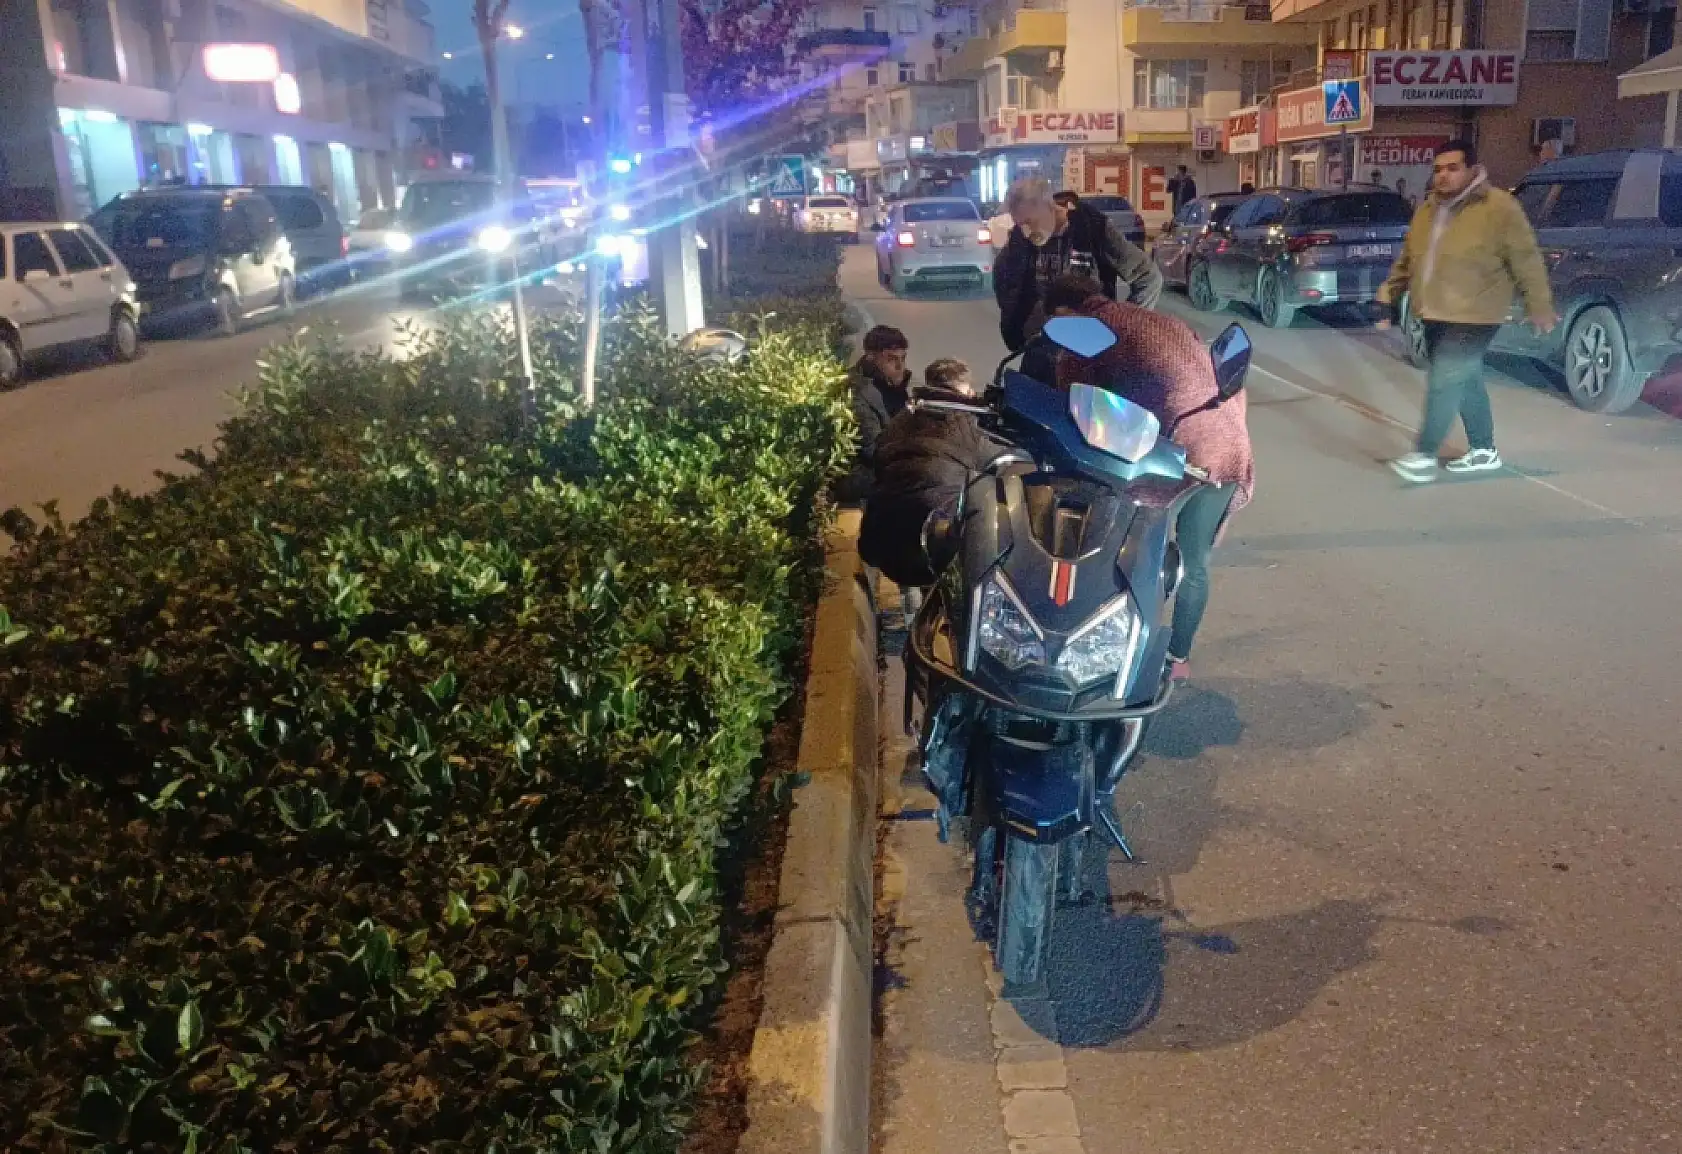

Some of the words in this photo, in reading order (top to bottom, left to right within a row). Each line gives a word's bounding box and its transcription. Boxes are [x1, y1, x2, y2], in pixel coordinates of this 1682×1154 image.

[1373, 55, 1515, 85] ECZANE
[1031, 112, 1115, 131] ECZANE
[1361, 144, 1434, 164] MEDİKA
[1141, 166, 1165, 211] E
